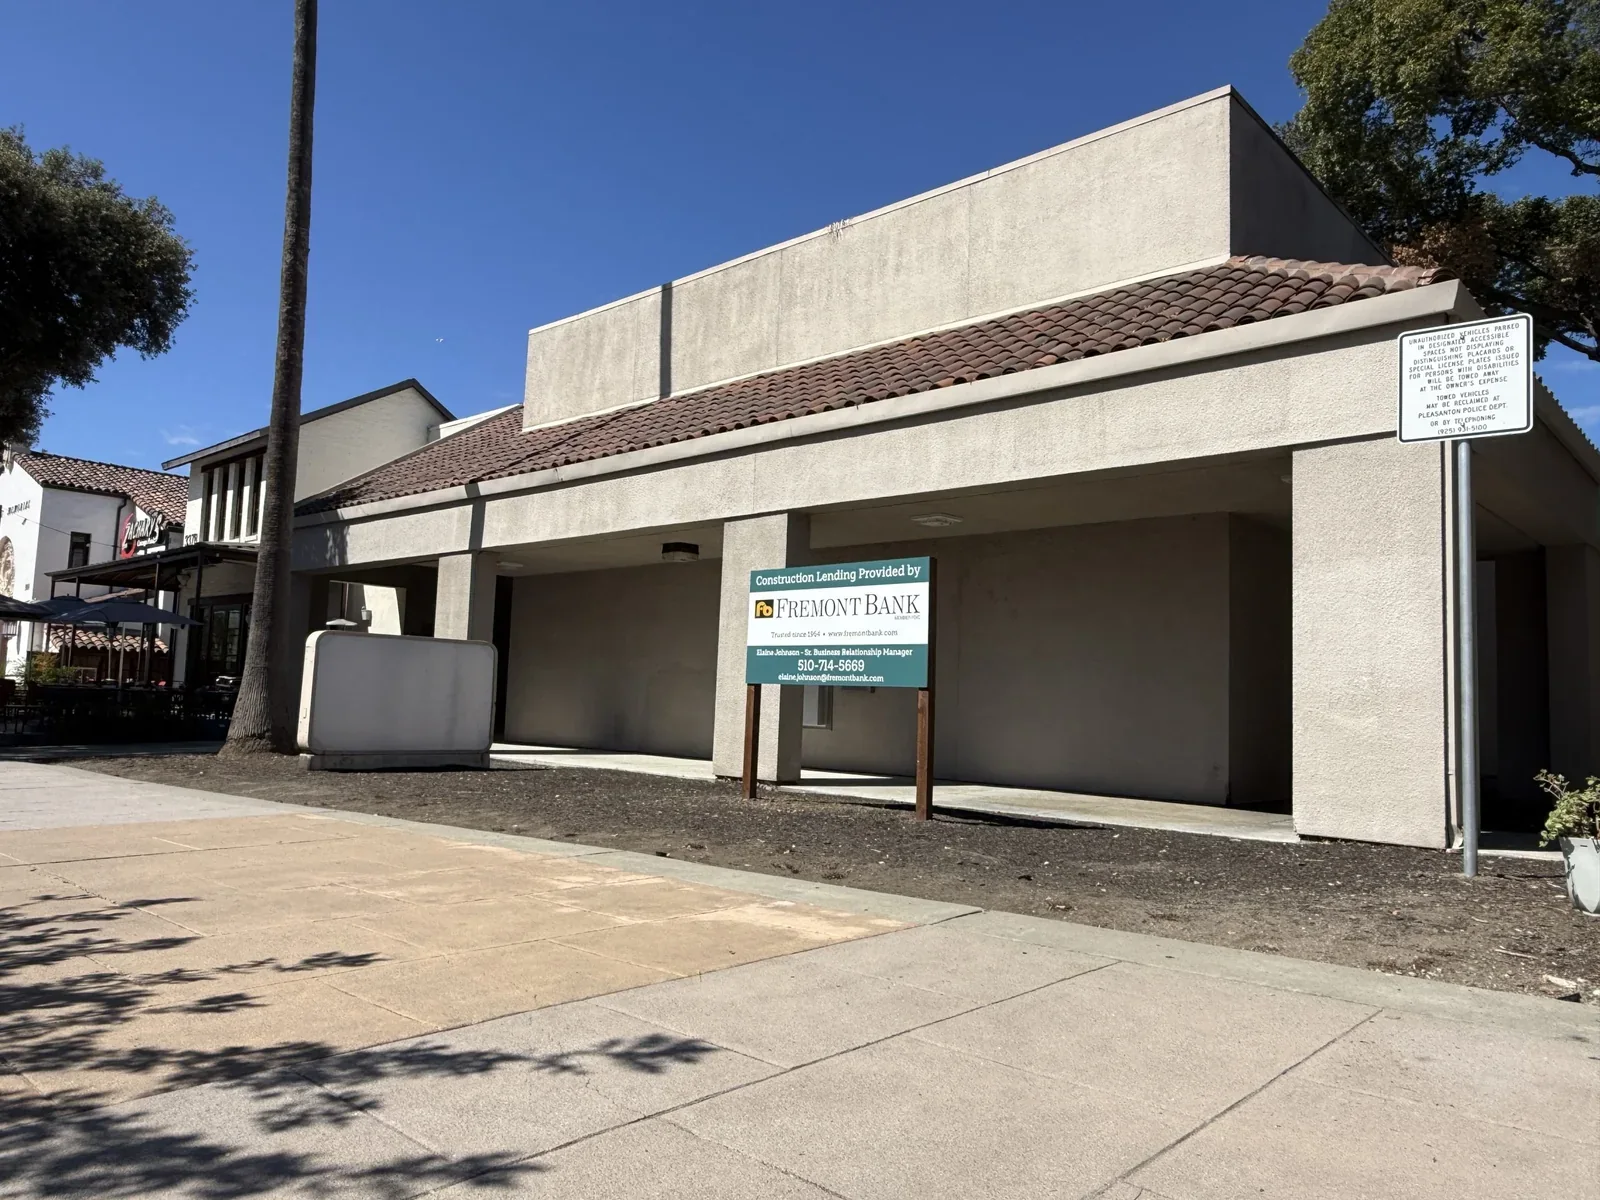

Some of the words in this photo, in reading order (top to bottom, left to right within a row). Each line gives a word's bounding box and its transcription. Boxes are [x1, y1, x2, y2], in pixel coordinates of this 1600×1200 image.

[1409, 333, 1455, 345] UNAUTHORIZED
[1460, 328, 1489, 337] VEHICLES
[1495, 323, 1519, 332] PARKED
[1429, 338, 1465, 348] DESIGNATED
[1471, 332, 1509, 342] ACCESSIBLE
[1423, 348, 1445, 356] SPACES
[1466, 340, 1503, 350] DISPLAYING
[1414, 353, 1462, 365] DISTINGUISHING
[1468, 348, 1500, 357] PLACARDS
[1468, 356, 1491, 364] PLATES
[1425, 369, 1453, 377] PERSONS
[1477, 360, 1519, 371] DISABILITIES
[1446, 381, 1474, 389] OWNER'S
[1479, 376, 1507, 385] EXPENSE
[1460, 390, 1489, 398] VEHICLES
[1454, 397, 1488, 406] RECLAIMED
[1418, 409, 1461, 418] PLEASANTON
[1455, 414, 1496, 424] TELEPHONING
[756, 572, 814, 586] Construction
[817, 570, 856, 582] Lending
[859, 566, 904, 579] Provided
[908, 564, 921, 578] by
[776, 598, 861, 618] FREMONT
[865, 594, 920, 615] BANK
[842, 649, 881, 657] Relationship
[883, 649, 913, 657] Manager
[798, 660, 864, 671] 510-714-5669
